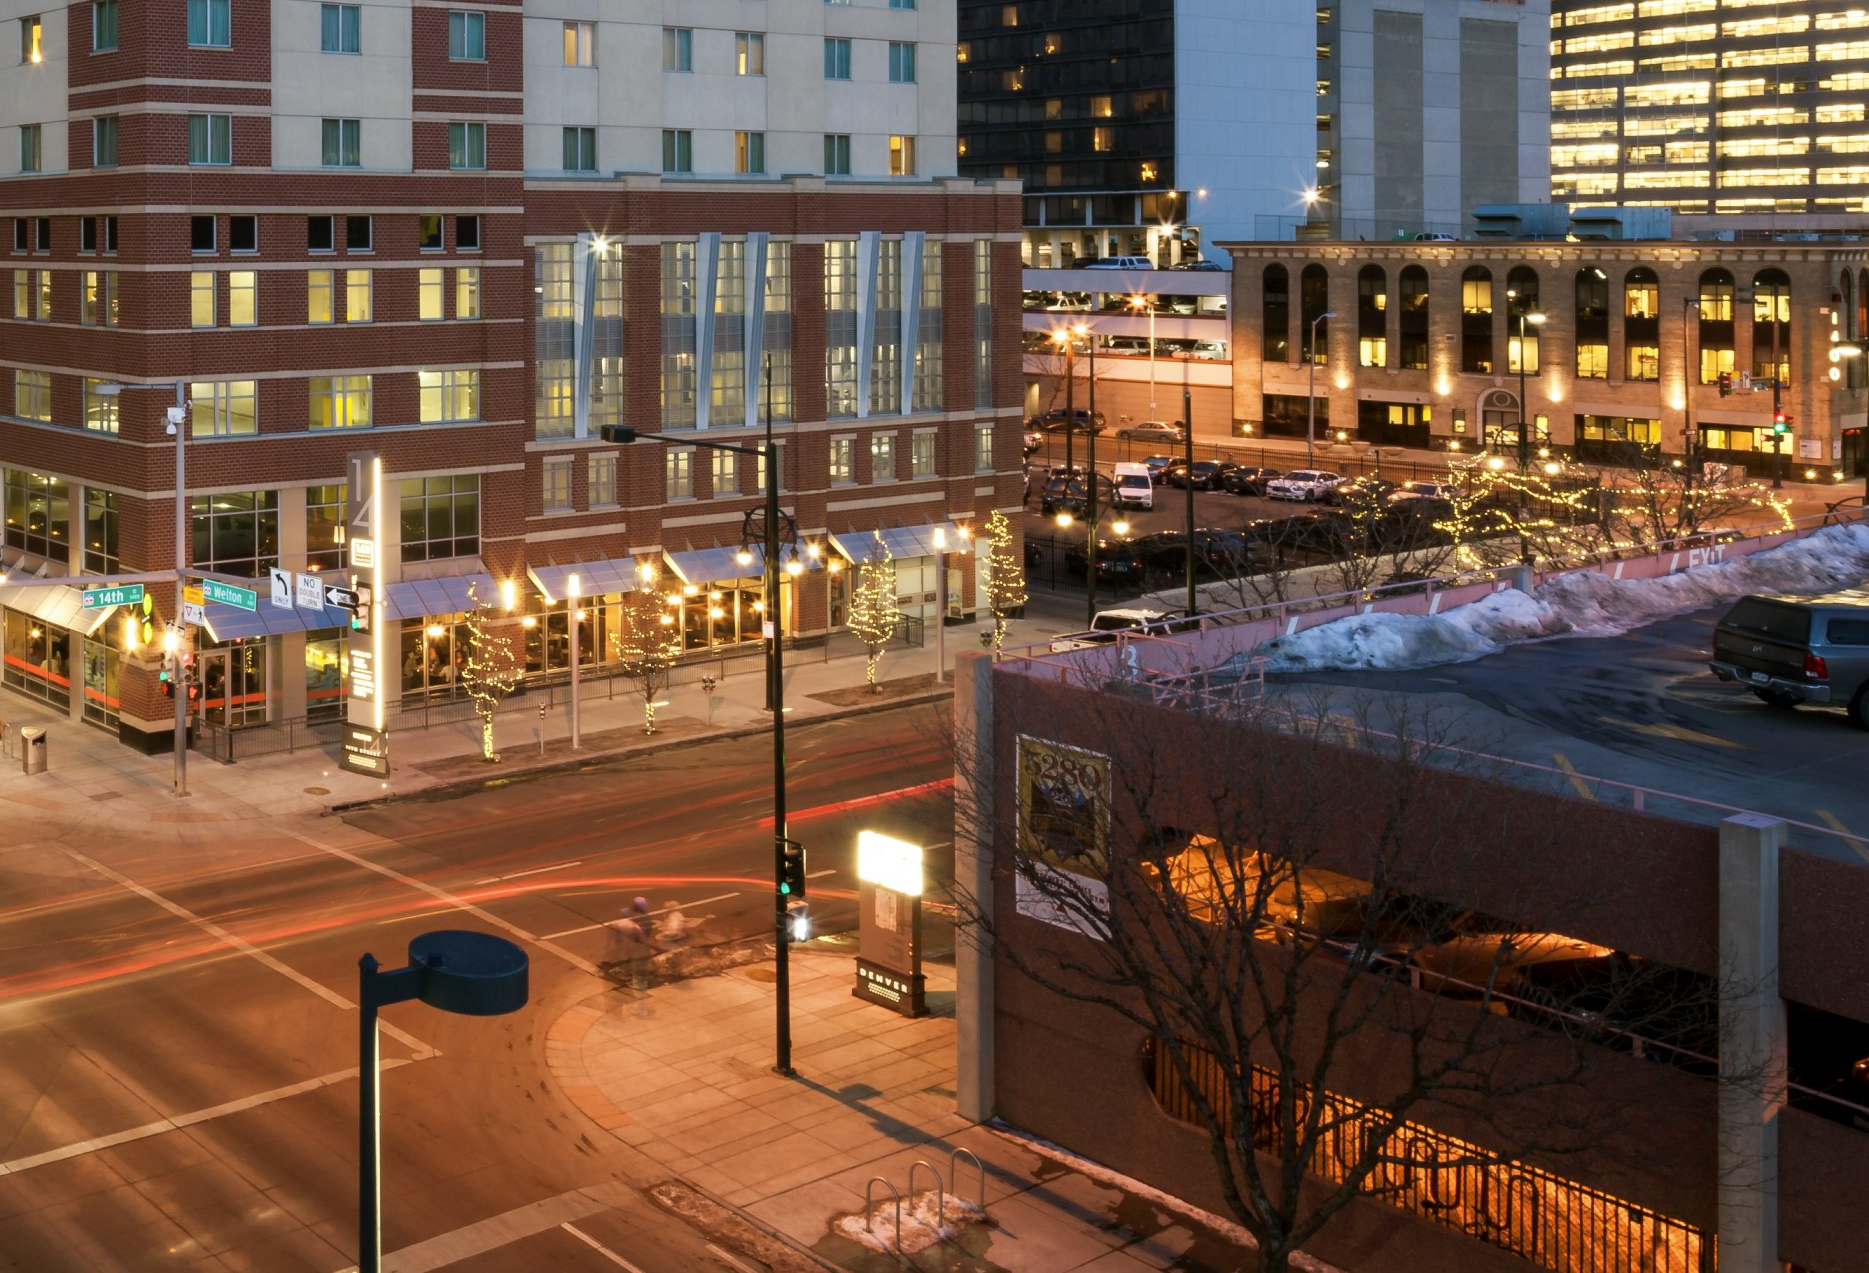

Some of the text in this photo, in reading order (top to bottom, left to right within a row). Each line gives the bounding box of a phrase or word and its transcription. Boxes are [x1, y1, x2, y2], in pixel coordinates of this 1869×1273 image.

[1689, 544, 1726, 569] EXIT
[303, 577, 315, 589] NO
[99, 590, 124, 604] 14th
[214, 586, 242, 604] Welton
[275, 596, 289, 605] ONLY
[299, 588, 320, 599] DOUBLE
[302, 598, 318, 608] TURN
[1025, 749, 1102, 791] 5280
[859, 967, 908, 994] DENVER
